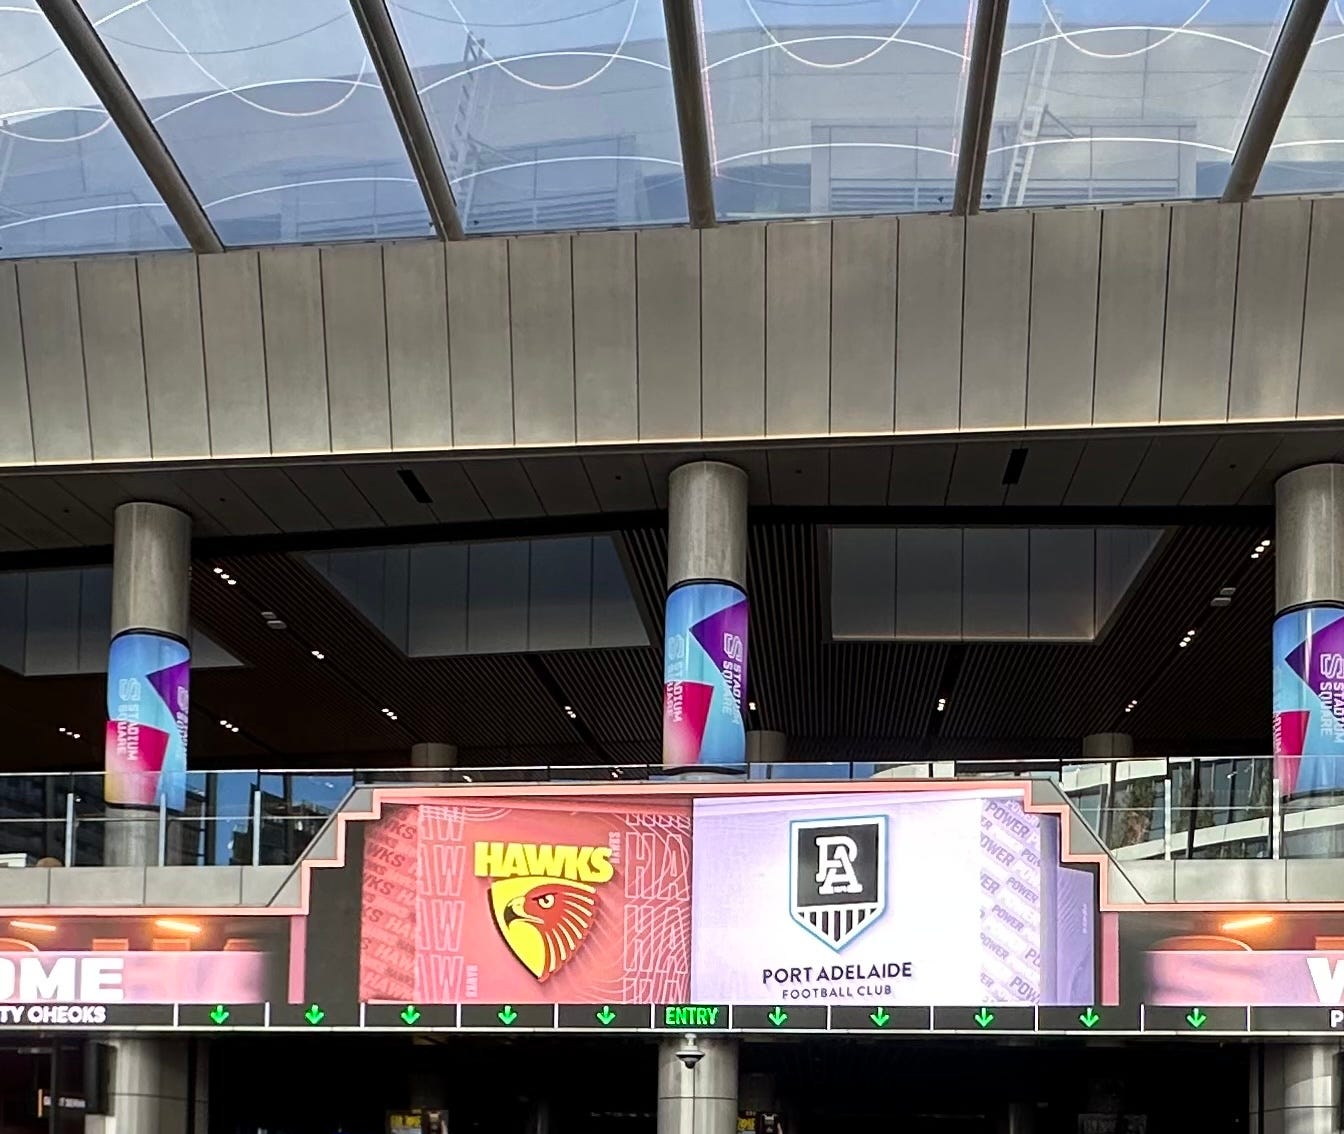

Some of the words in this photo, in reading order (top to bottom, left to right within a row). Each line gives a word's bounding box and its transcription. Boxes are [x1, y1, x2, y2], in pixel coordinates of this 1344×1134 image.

[474, 841, 614, 883] HAWKS
[762, 967, 813, 984] PORT
[816, 962, 913, 982] ADELAIDE
[782, 986, 853, 999] FOOTBALL
[856, 985, 892, 997] CLUB
[28, 1005, 106, 1024] CHECKS
[665, 1006, 719, 1025] ENTRY
